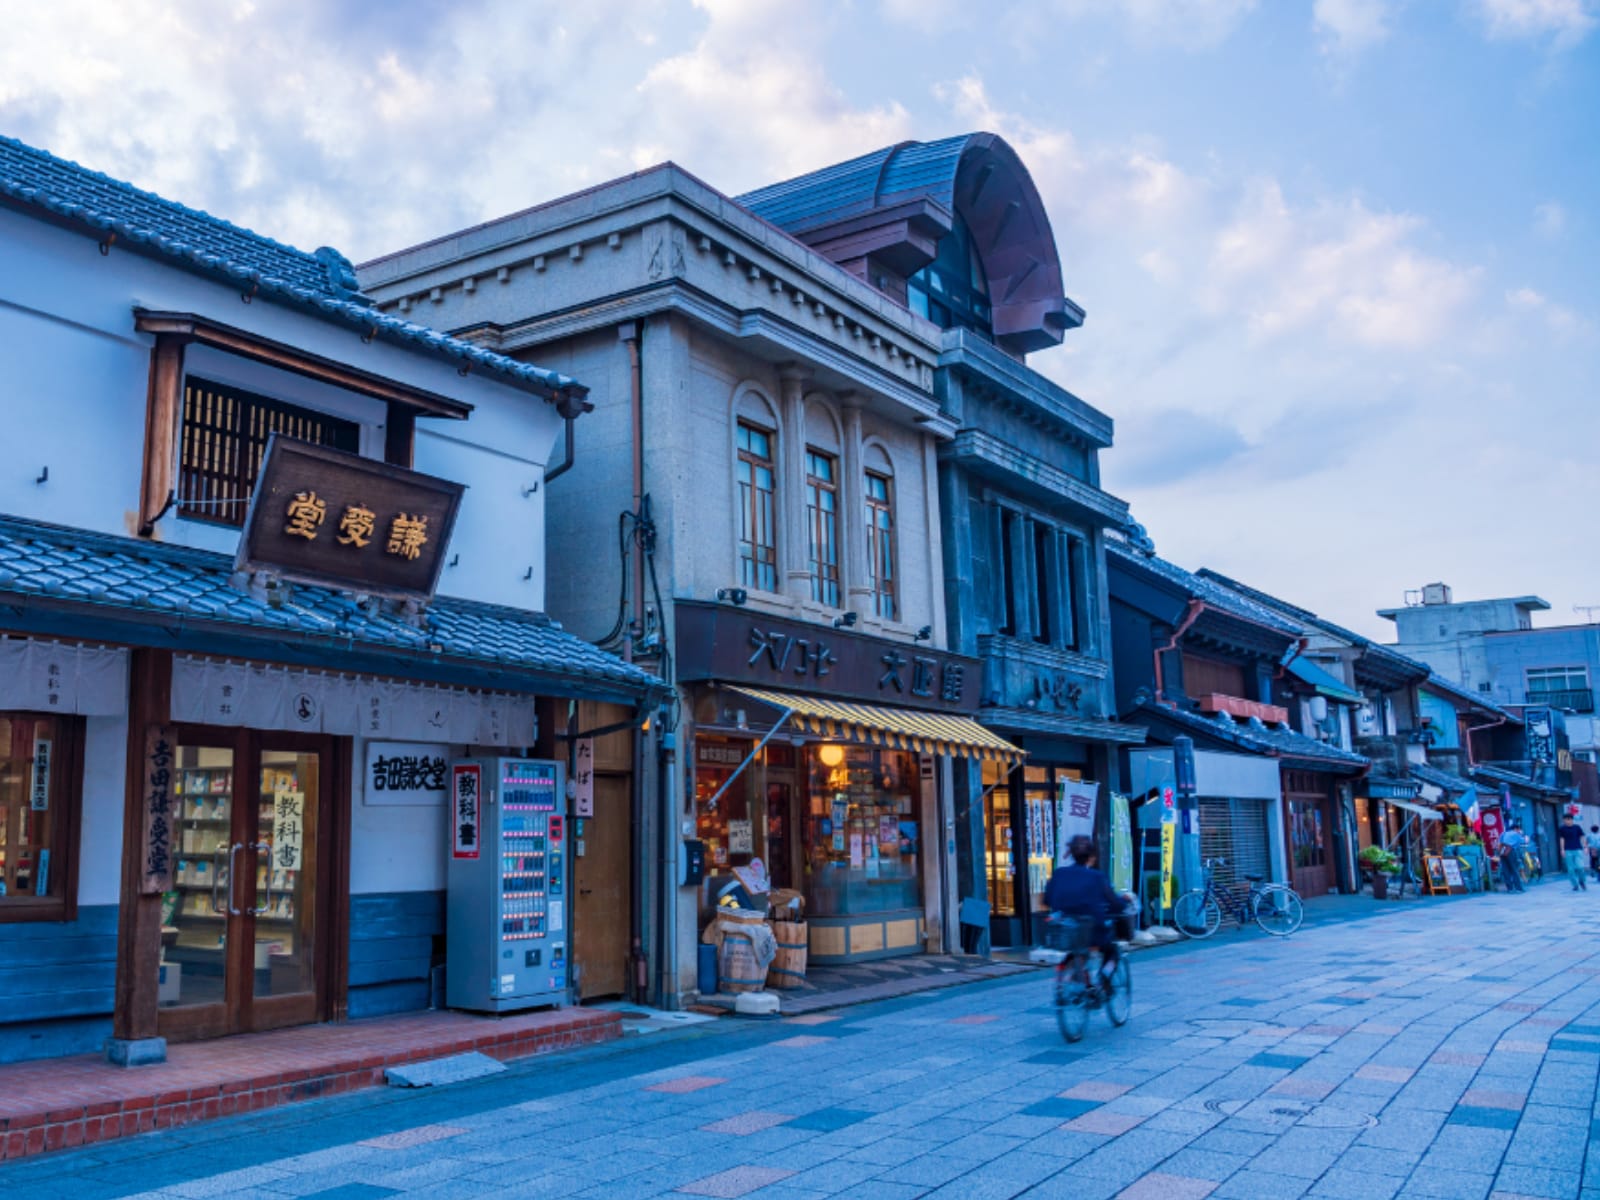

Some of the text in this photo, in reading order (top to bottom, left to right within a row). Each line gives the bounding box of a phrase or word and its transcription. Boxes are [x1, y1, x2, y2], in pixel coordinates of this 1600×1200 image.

[458, 773, 477, 847] 教科書
[577, 742, 591, 814] たばこ
[274, 796, 303, 868] 教科書
